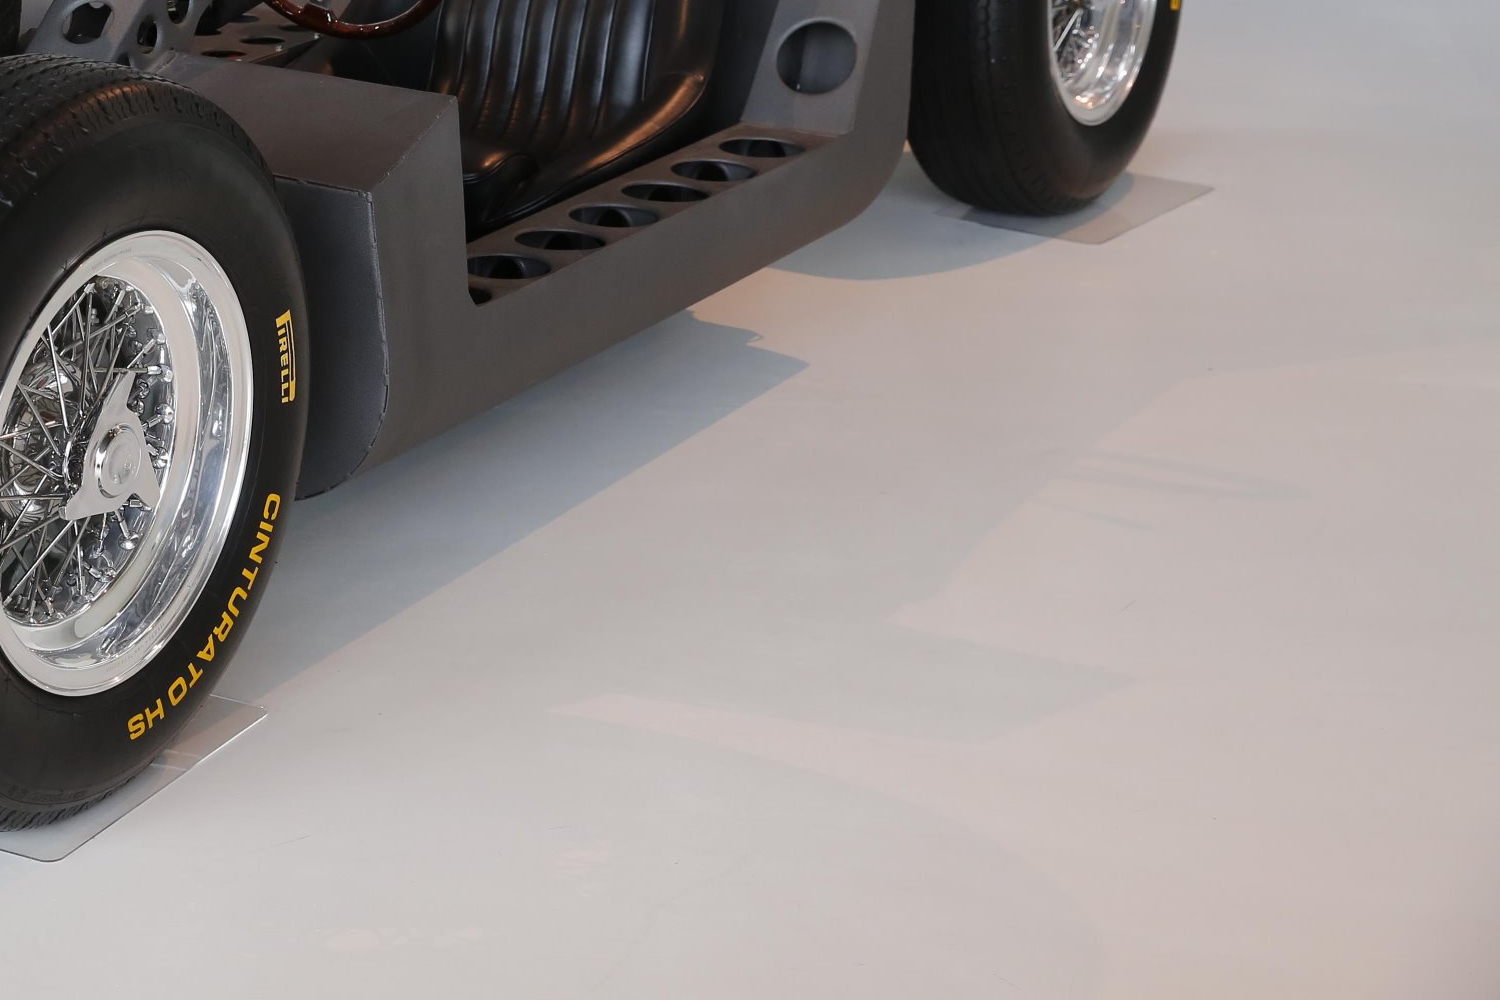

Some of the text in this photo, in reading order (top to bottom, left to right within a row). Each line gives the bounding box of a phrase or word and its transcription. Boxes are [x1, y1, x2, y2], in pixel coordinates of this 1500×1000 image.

[275, 309, 296, 404] PIRELLI
[167, 493, 281, 707] CINTURATO
[127, 698, 165, 740] HS
